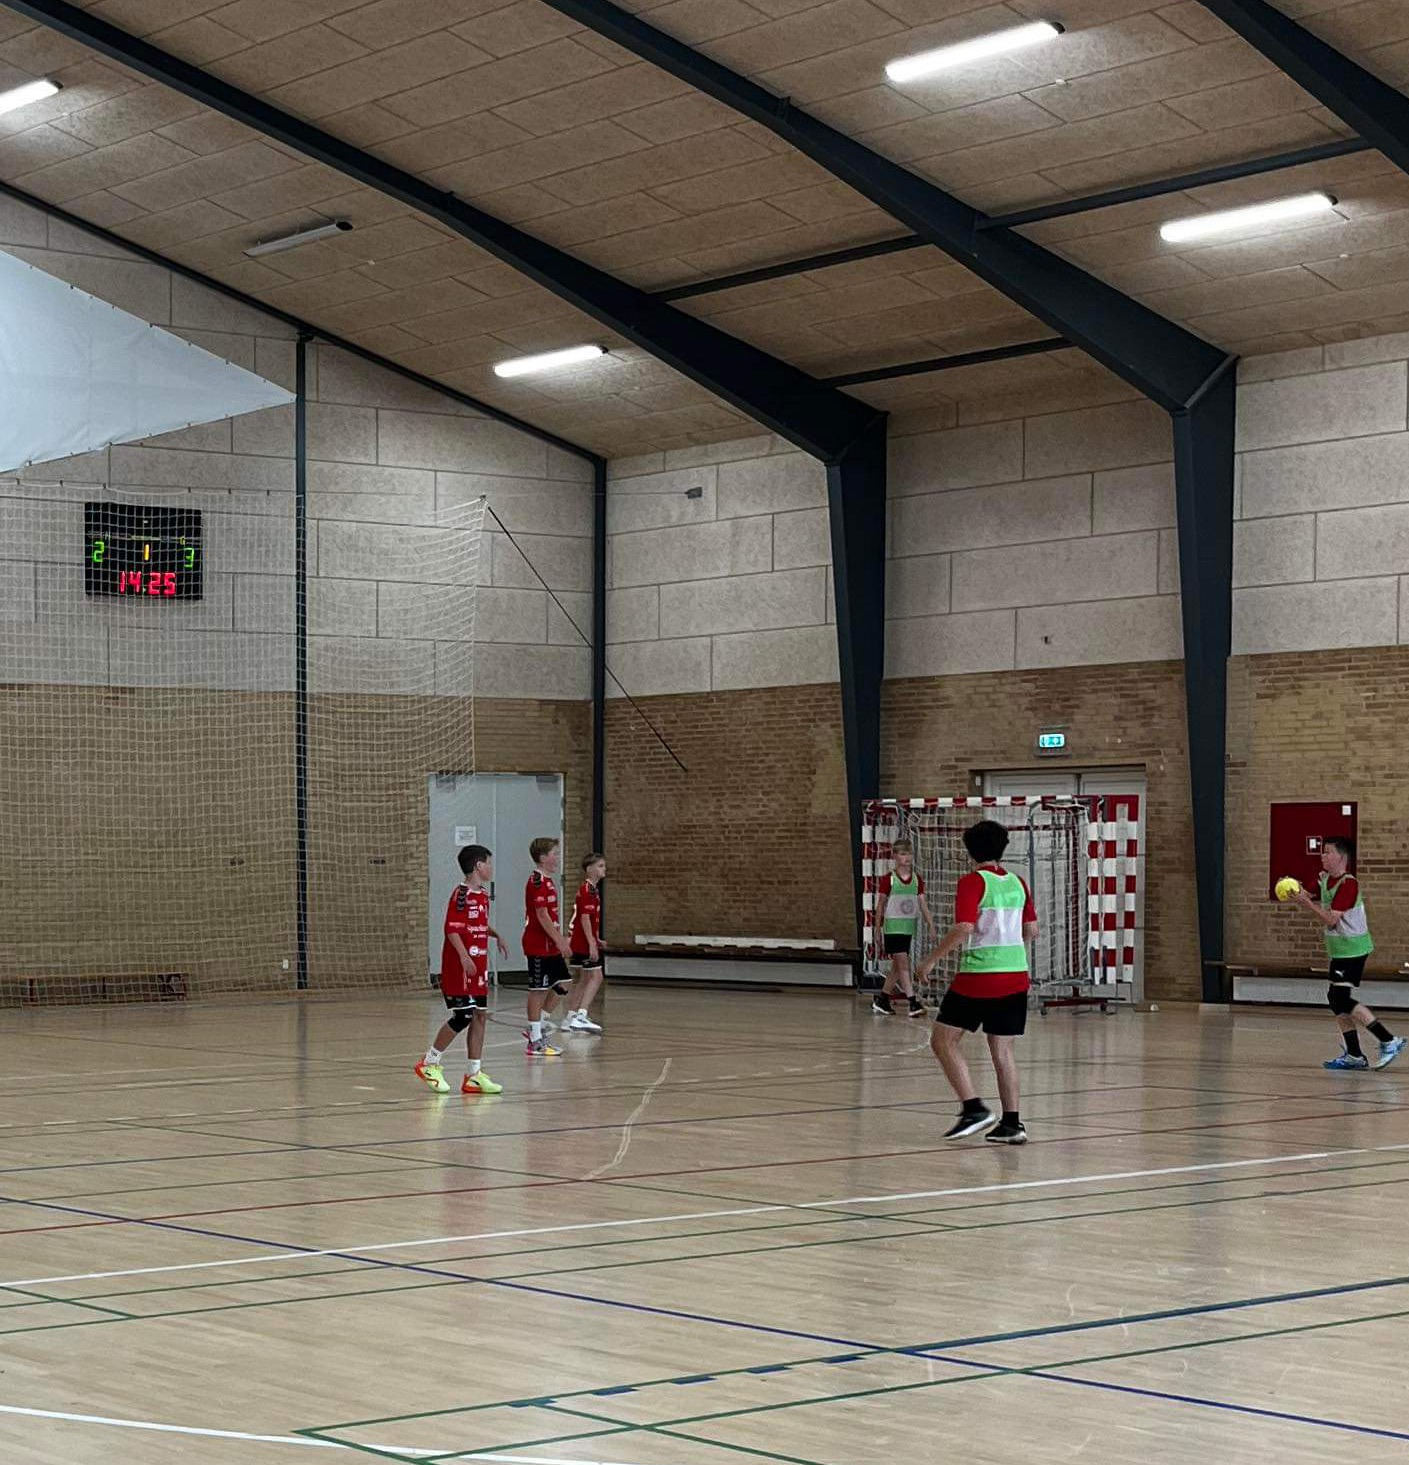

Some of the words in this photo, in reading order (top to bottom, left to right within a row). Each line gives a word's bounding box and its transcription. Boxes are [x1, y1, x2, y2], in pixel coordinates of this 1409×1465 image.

[92, 540, 105, 563] 2
[143, 543, 150, 561] 1
[183, 547, 195, 568] 3
